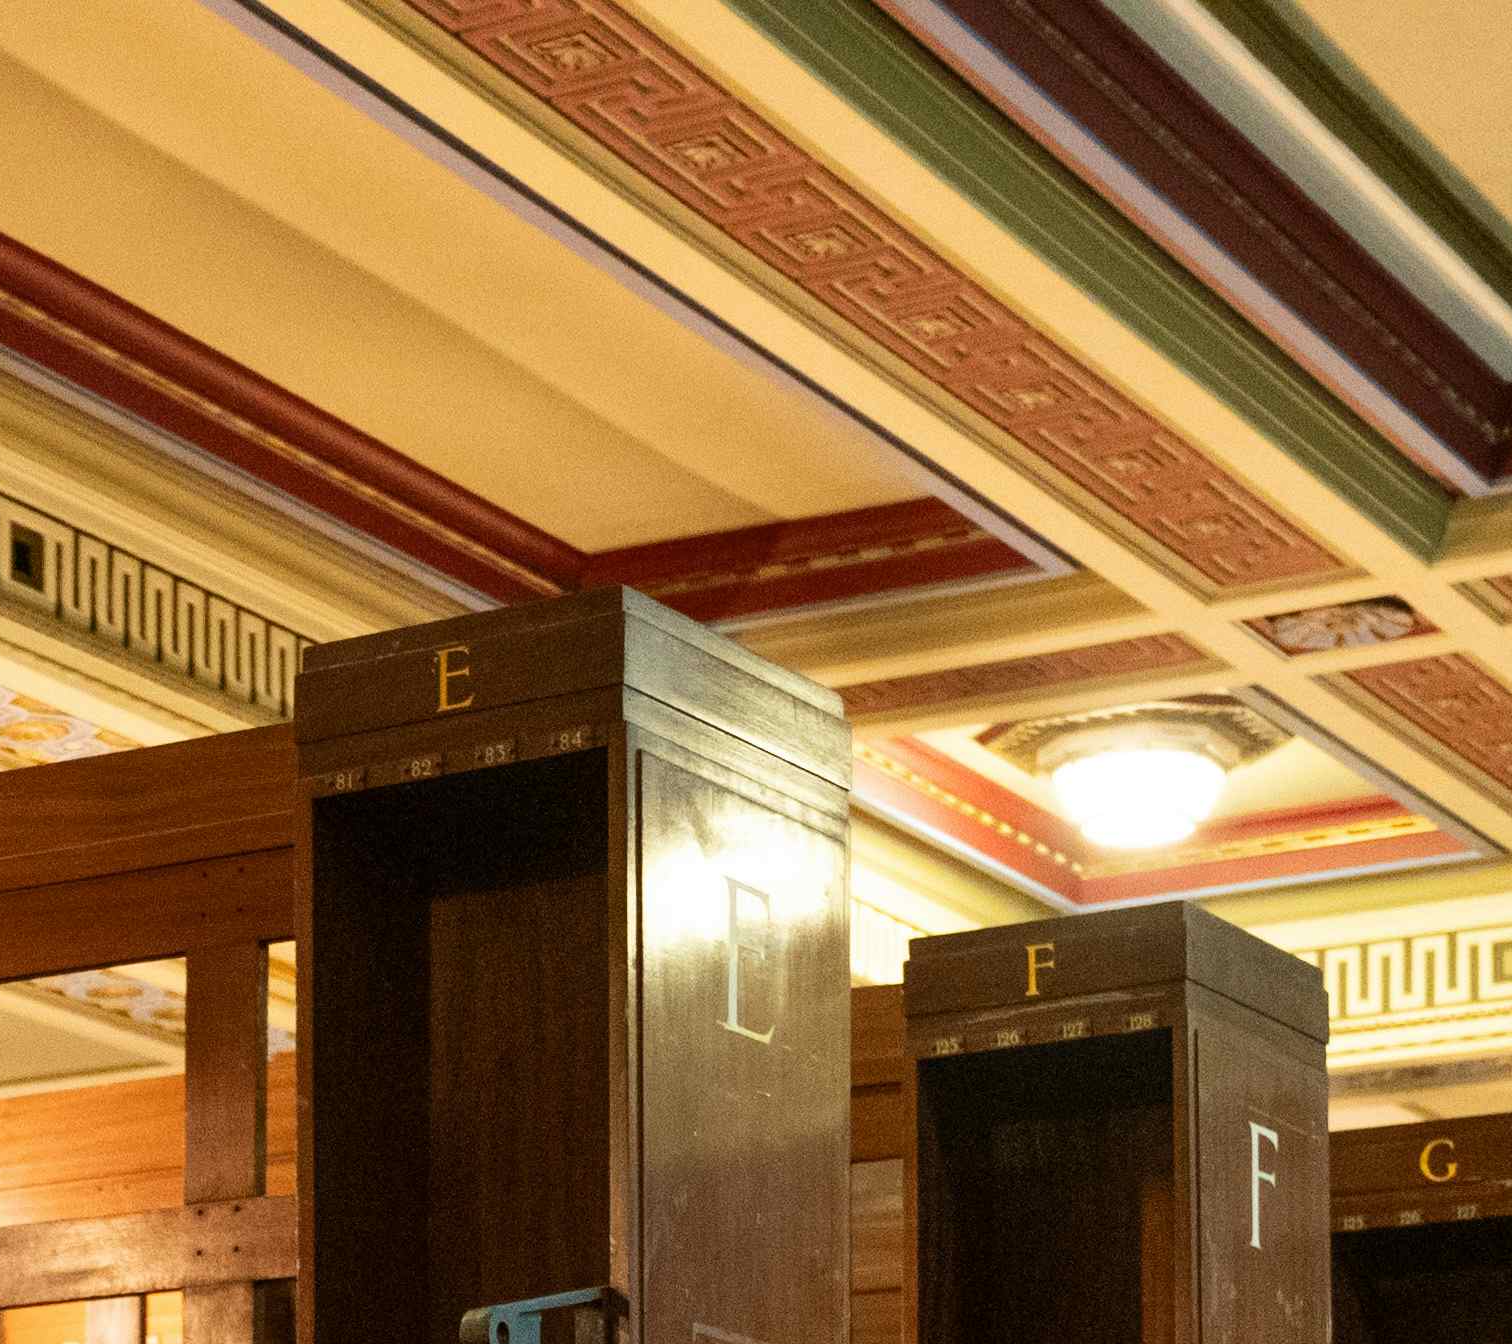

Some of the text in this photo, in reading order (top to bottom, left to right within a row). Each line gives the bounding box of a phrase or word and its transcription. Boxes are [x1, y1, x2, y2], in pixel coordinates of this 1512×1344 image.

[436, 645, 474, 712] E
[336, 731, 582, 790] 81 82 83 84
[1026, 943, 1055, 996] F
[1129, 1014, 1152, 1031] 128
[1249, 1120, 1279, 1250] F
[1419, 1138, 1457, 1182] G
